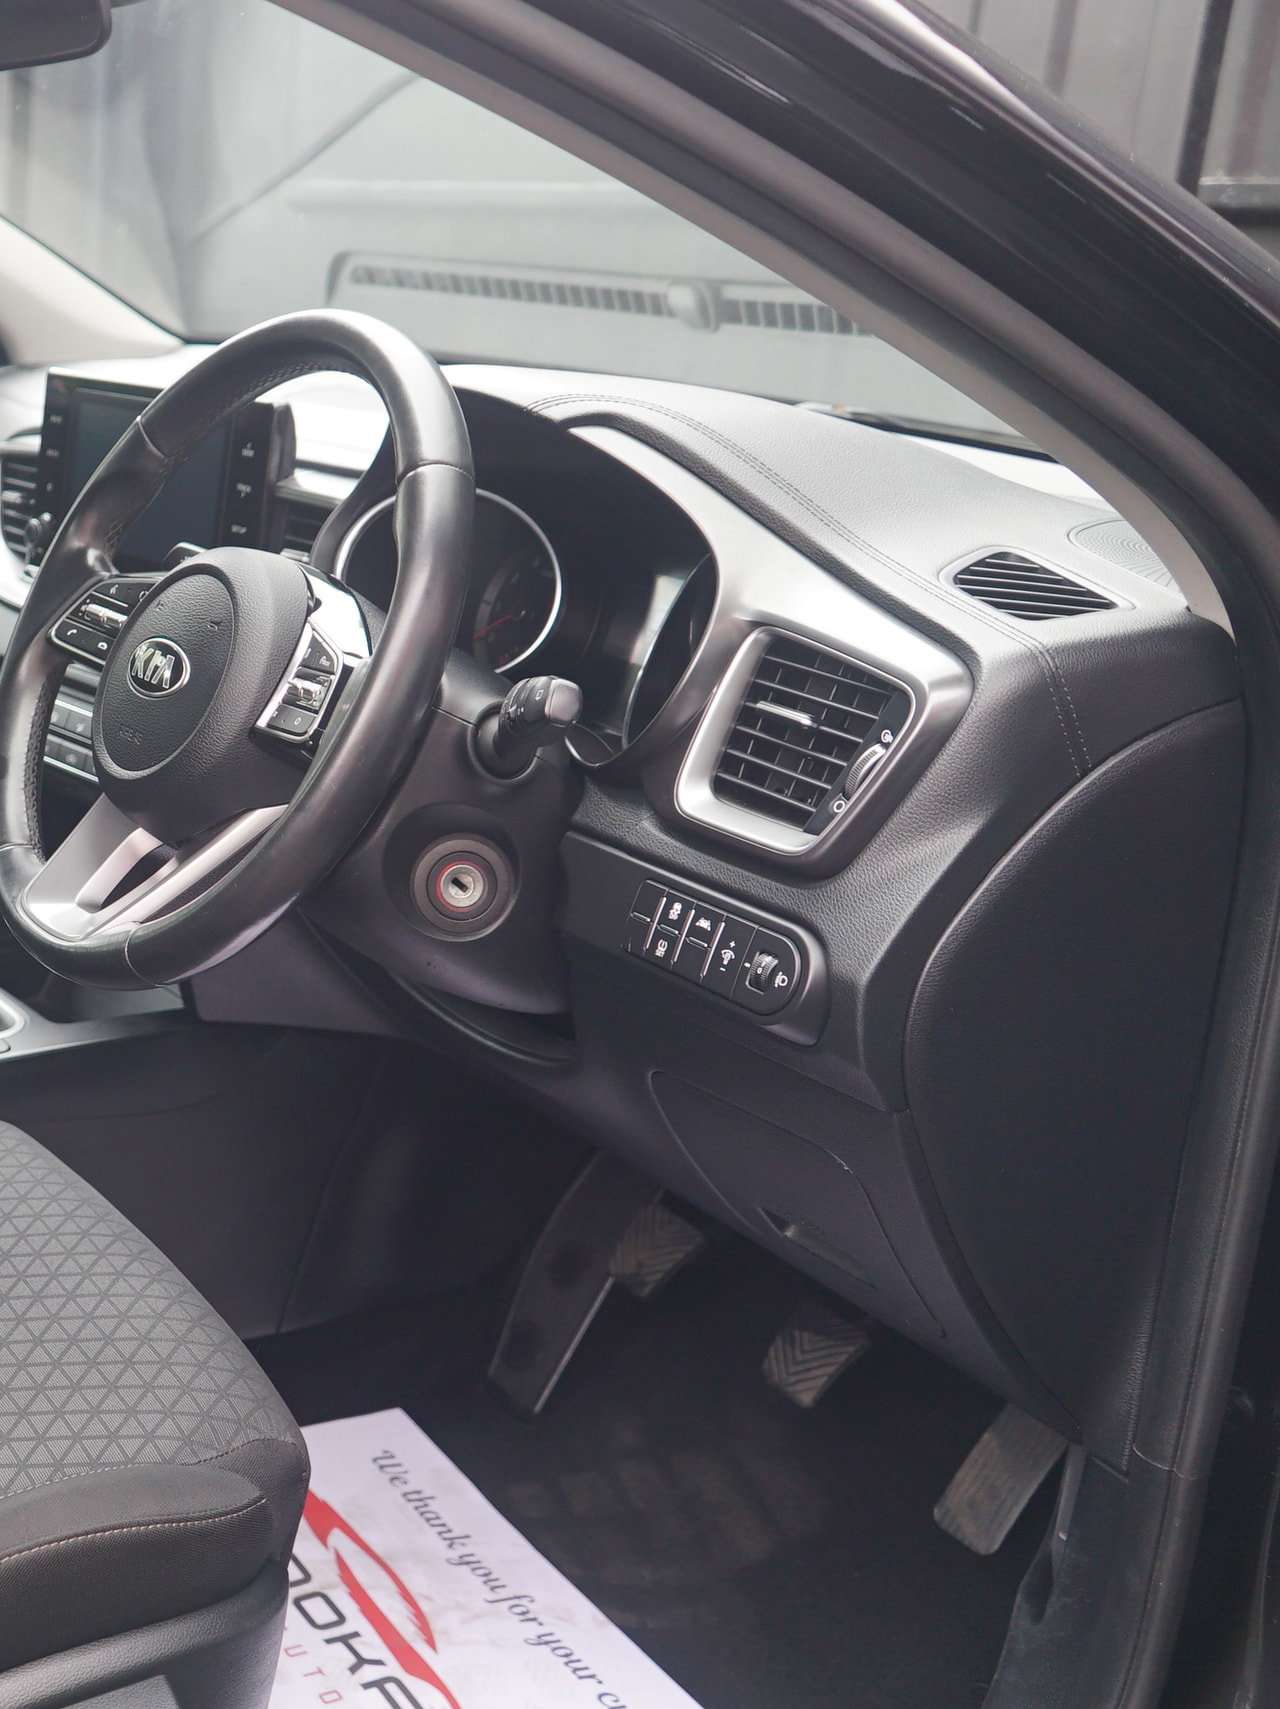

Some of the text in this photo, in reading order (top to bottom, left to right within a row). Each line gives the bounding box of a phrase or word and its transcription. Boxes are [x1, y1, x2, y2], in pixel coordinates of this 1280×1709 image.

[131, 644, 175, 689] KIA
[372, 1449, 627, 1709] We thank you for your c
[283, 1626, 343, 1705] UTO
